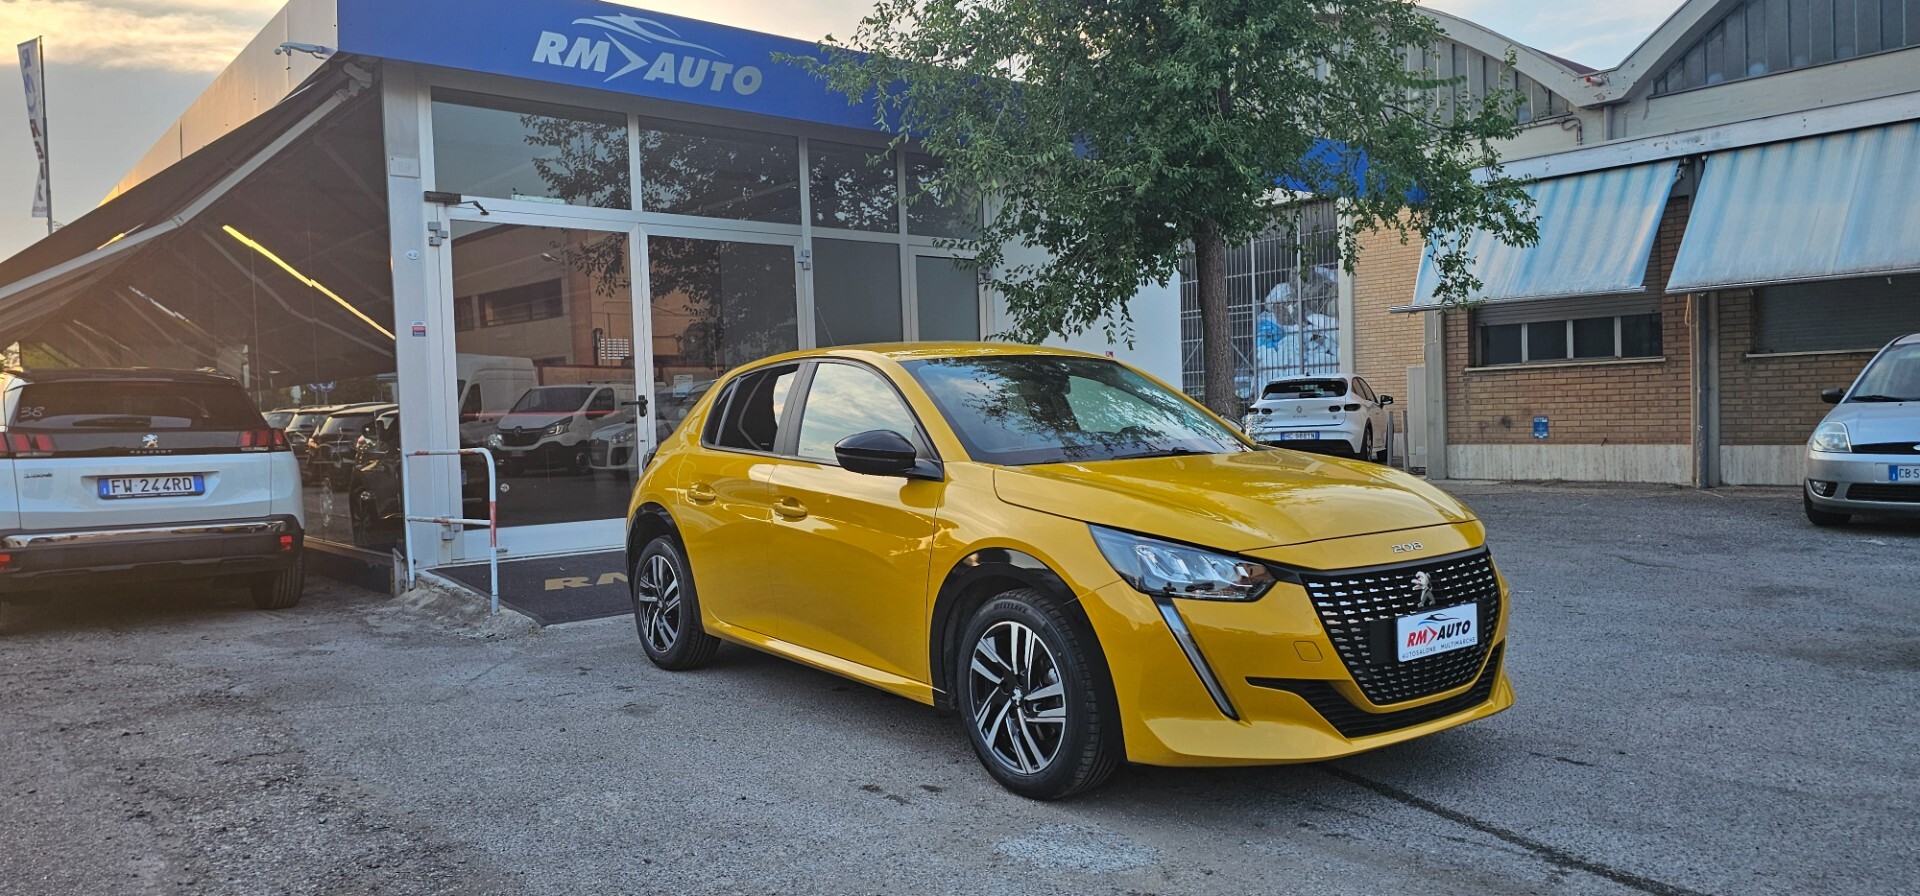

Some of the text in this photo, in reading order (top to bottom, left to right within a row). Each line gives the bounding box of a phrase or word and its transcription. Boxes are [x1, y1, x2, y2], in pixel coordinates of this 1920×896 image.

[532, 30, 763, 96] RM AUTO
[20, 406, 45, 418] 38
[1898, 468, 1911, 479] CB
[111, 479, 133, 494] FW
[140, 477, 193, 493] 244RD
[1392, 541, 1423, 553] 208
[1407, 620, 1471, 648] RM AUTO
[1402, 636, 1476, 659] AUTOSALONE MULTIMARCHE
